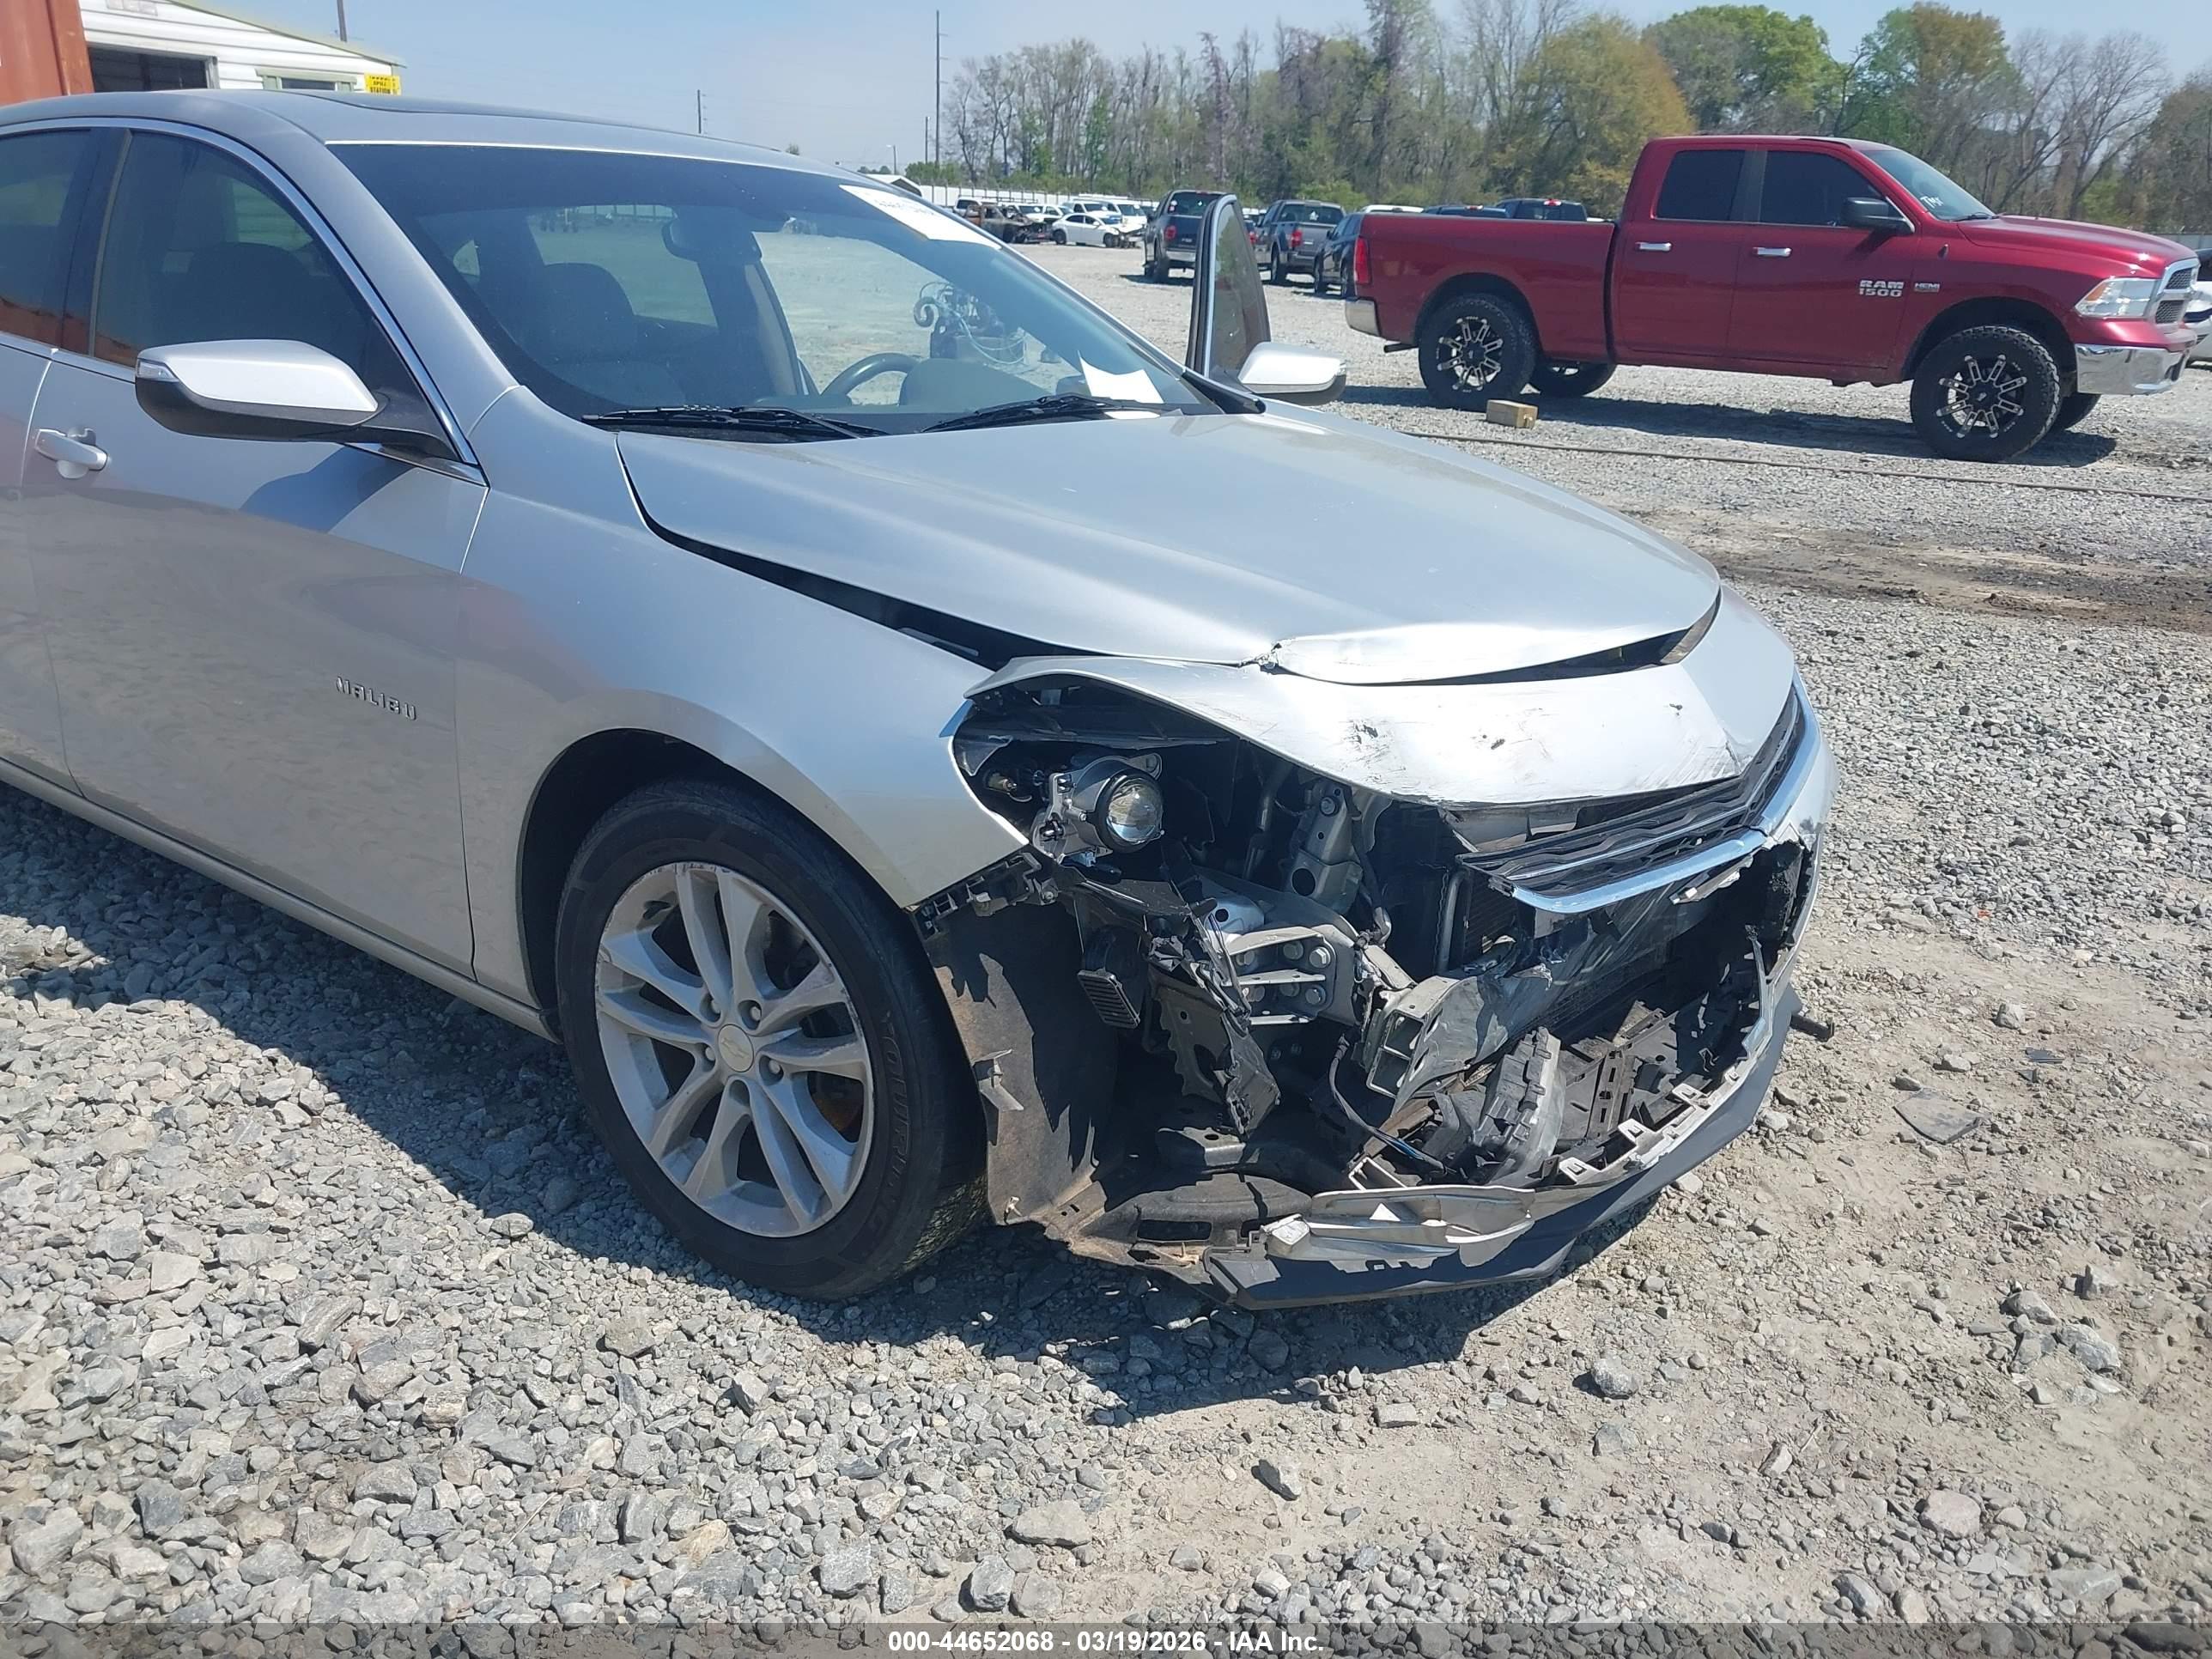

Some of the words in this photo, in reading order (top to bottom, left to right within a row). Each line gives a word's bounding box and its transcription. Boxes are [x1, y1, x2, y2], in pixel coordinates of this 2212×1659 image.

[1859, 279, 1905, 289] RAM
[1914, 282, 1941, 290] HEMI
[1858, 288, 1903, 298] 1500
[335, 676, 417, 721] MALIBU
